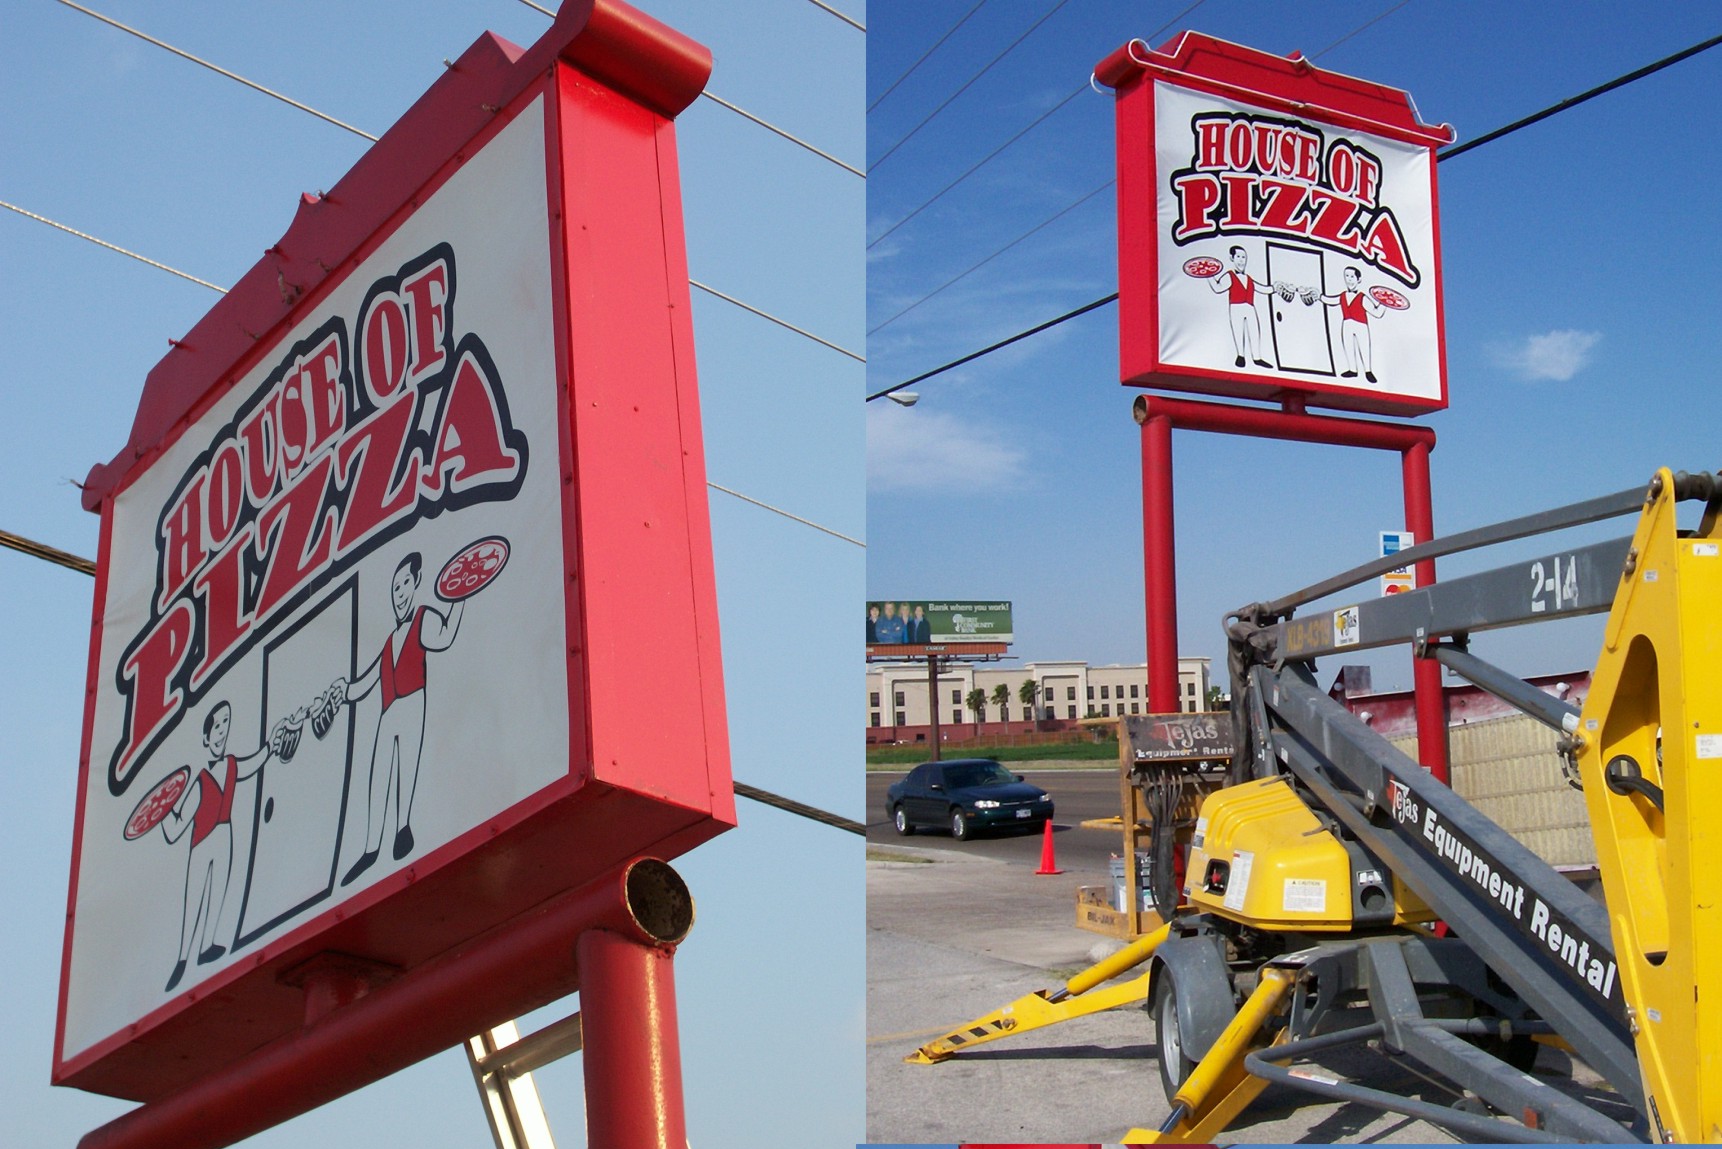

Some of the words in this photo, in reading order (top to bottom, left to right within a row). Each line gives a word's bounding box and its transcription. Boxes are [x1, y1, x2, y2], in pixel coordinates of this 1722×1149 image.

[1196, 119, 1320, 182] HOUSE
[1329, 146, 1379, 206] OF
[1175, 173, 1416, 281] PIZZA
[160, 337, 344, 608] HOUSE
[362, 261, 448, 400] OF
[116, 350, 518, 778] PIZZA
[1530, 556, 1579, 612] 2-14
[928, 603, 949, 611] Bank
[950, 603, 973, 611] where
[974, 605, 987, 613] you
[987, 603, 1009, 611] work!
[1136, 748, 1198, 758] Equipmen
[1153, 719, 1218, 749] Tejas
[1389, 780, 1419, 824] Tejas
[1423, 808, 1525, 919] Equipment
[1531, 899, 1617, 999] Rental
